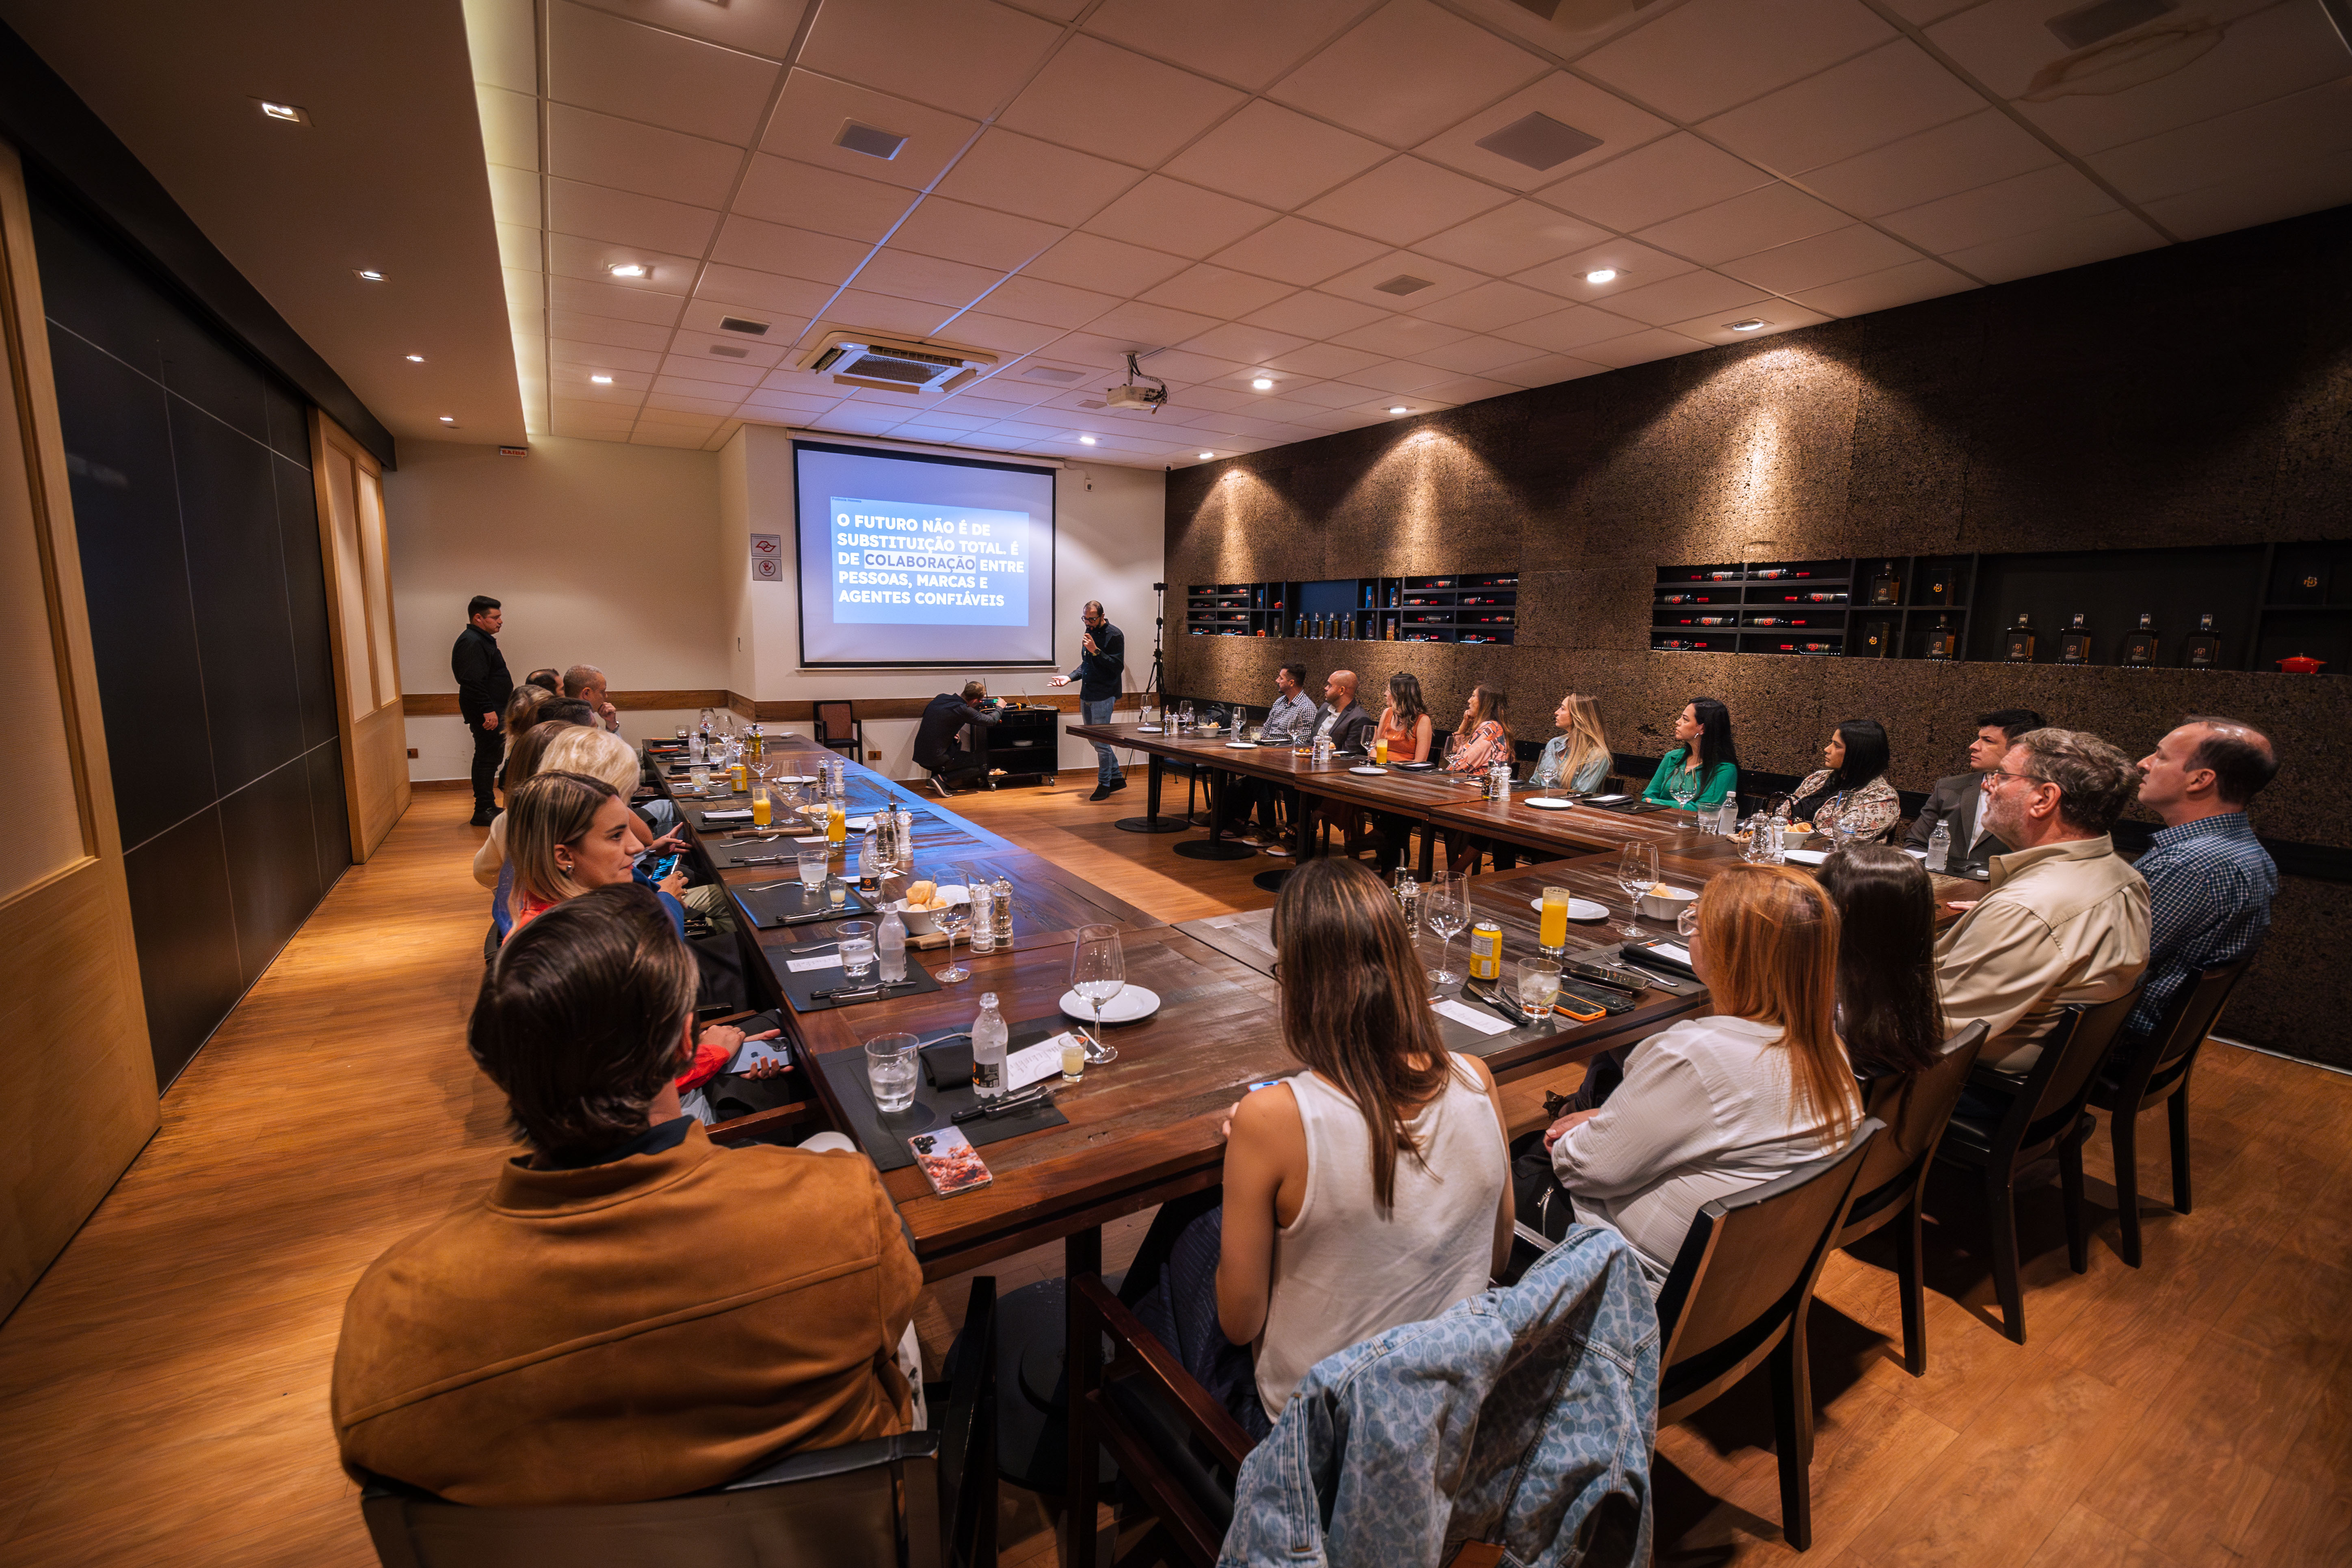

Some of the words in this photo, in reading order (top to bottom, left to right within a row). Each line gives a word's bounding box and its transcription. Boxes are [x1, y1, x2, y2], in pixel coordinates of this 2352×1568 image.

[837, 513, 850, 527] O
[855, 515, 918, 531] FUTURO
[922, 517, 954, 534] NÃO
[959, 519, 967, 535] É
[972, 523, 991, 536] DE
[837, 532, 955, 554] SUBSTITUIÇÃO
[959, 540, 1006, 555] TOTAL.
[1010, 541, 1019, 556] É
[838, 552, 860, 565] DE
[865, 553, 975, 573] COLABORAÇÃO
[980, 559, 1024, 573] ENTRE
[839, 571, 913, 588] PESSOAS,
[917, 574, 976, 588] MARCAS
[980, 577, 988, 588] E
[838, 590, 911, 604] AGENTES
[915, 590, 1004, 606] CONFIÁVEIS
